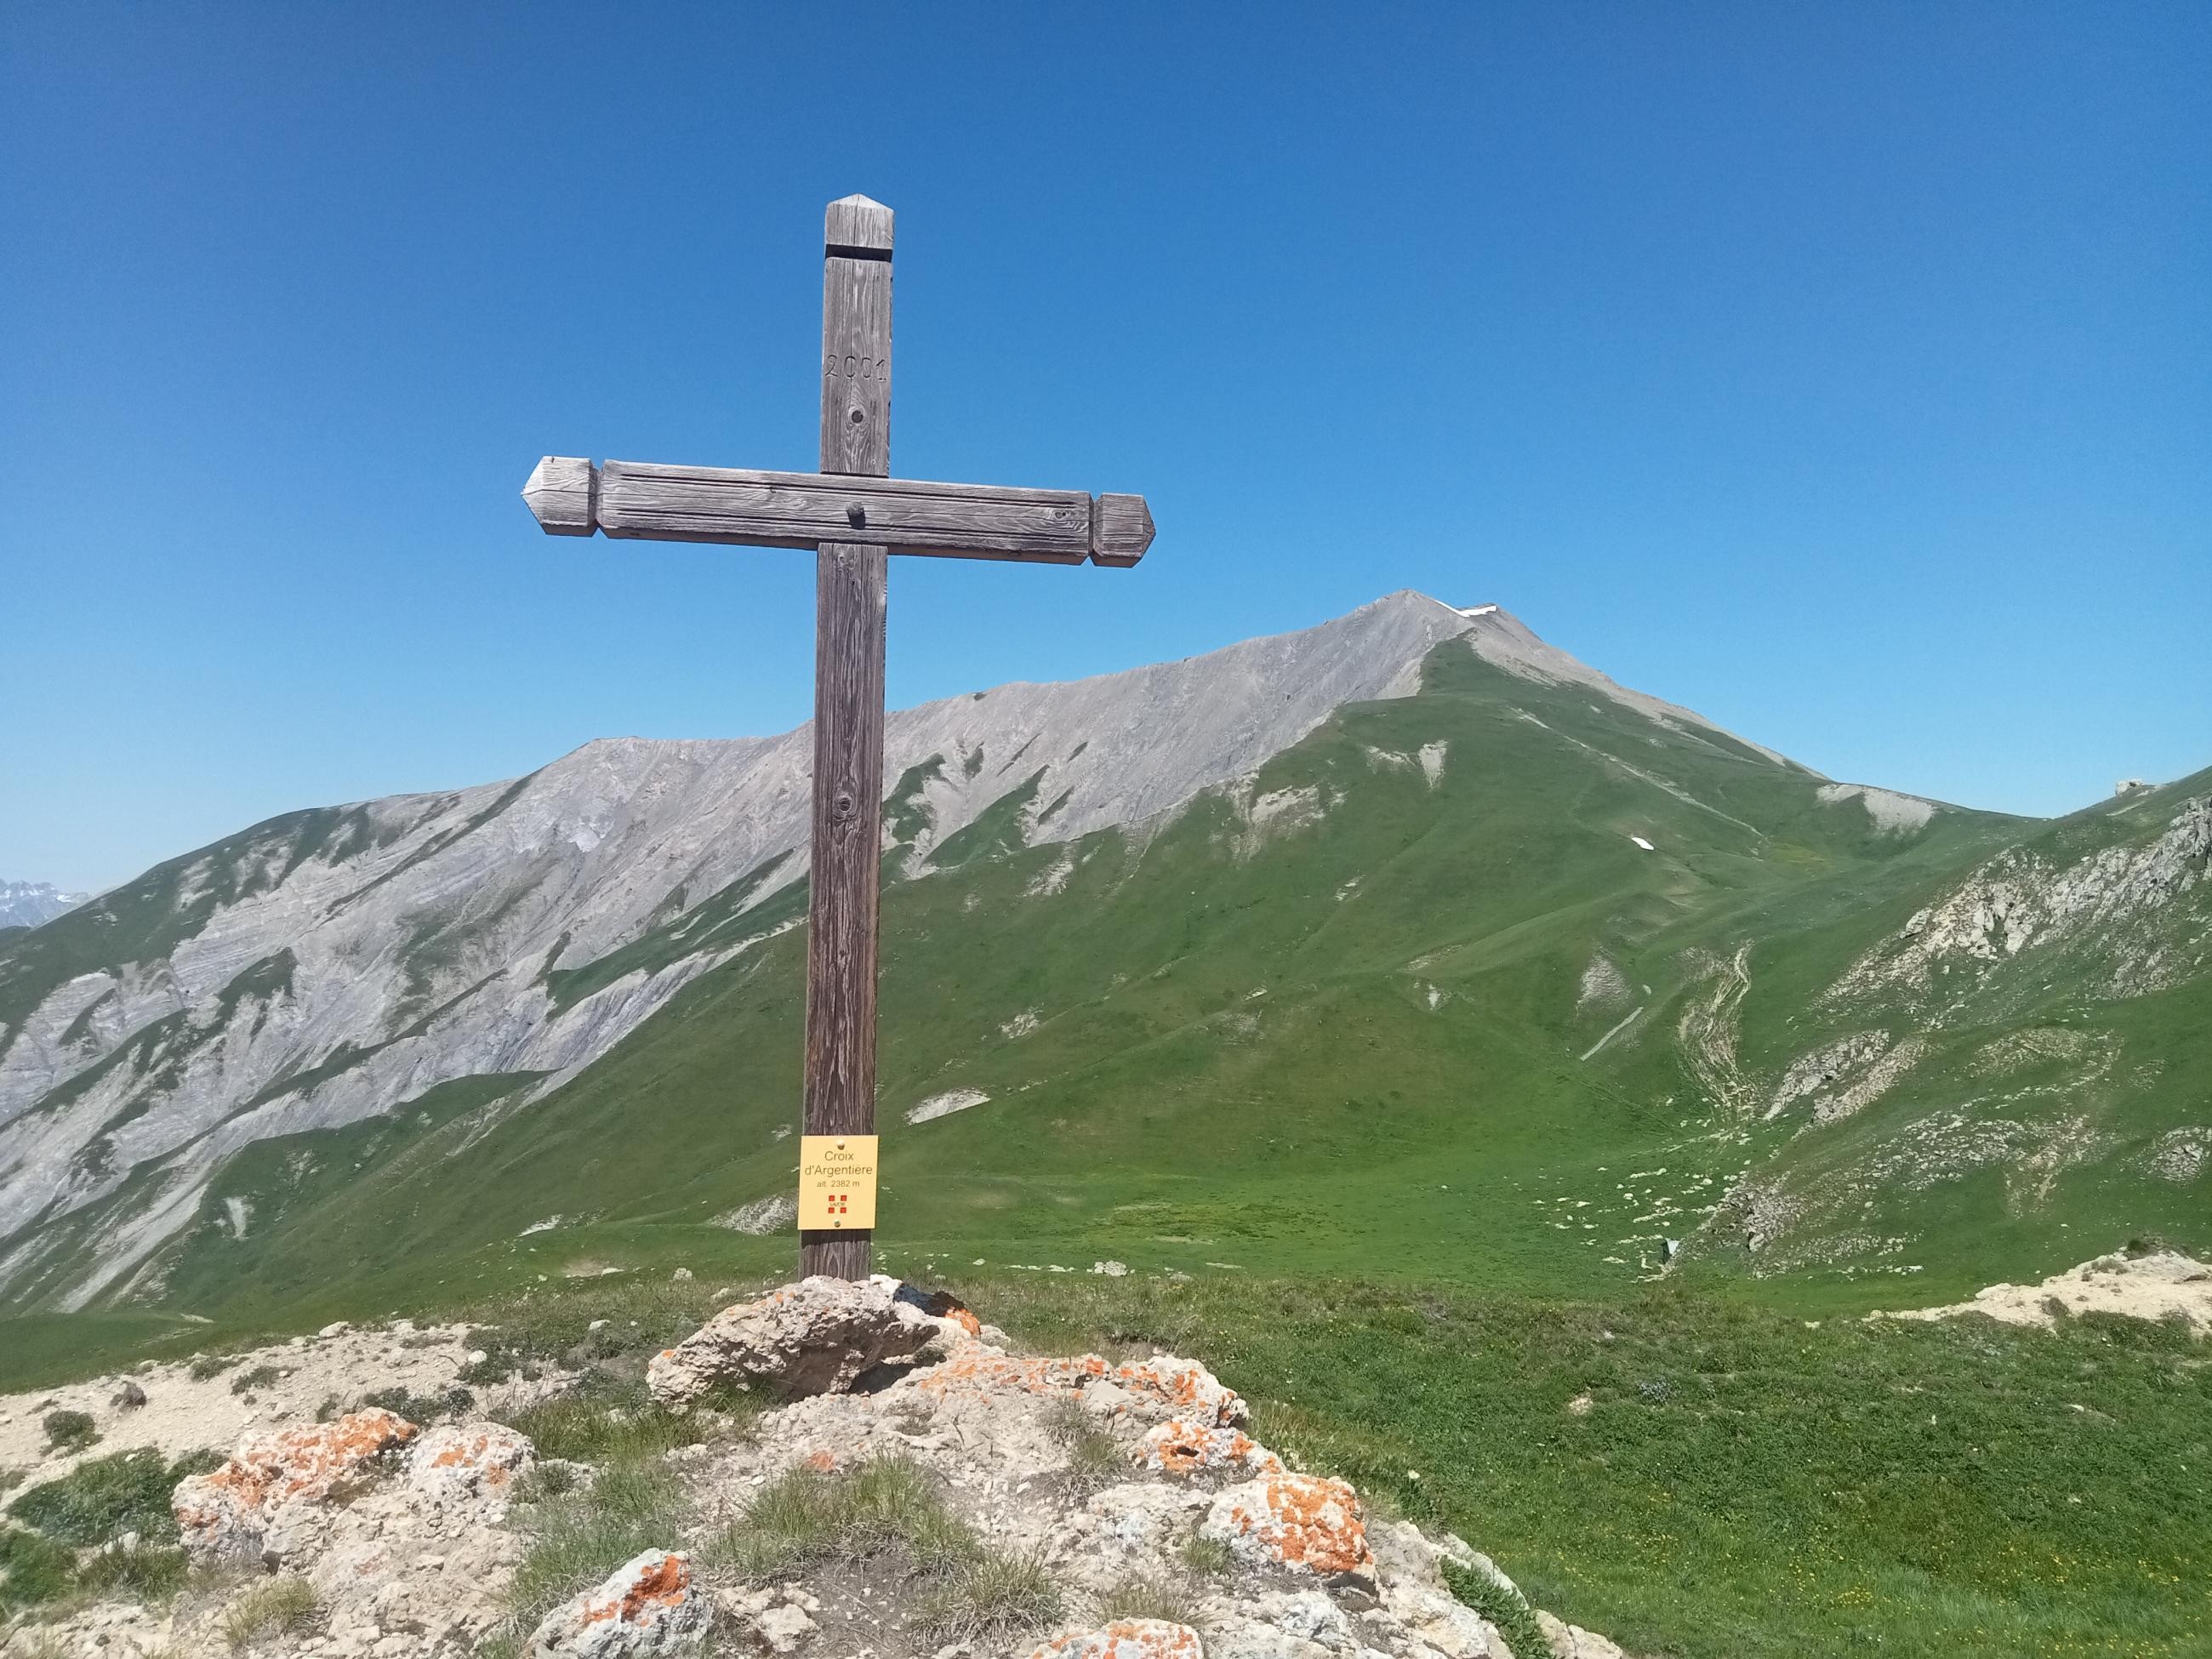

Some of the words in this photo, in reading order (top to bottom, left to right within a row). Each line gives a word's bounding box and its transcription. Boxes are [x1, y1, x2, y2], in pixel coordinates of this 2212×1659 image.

[825, 354, 887, 381] 2001
[824, 1150, 854, 1161] Croix
[804, 1165, 873, 1177] d'Argentière
